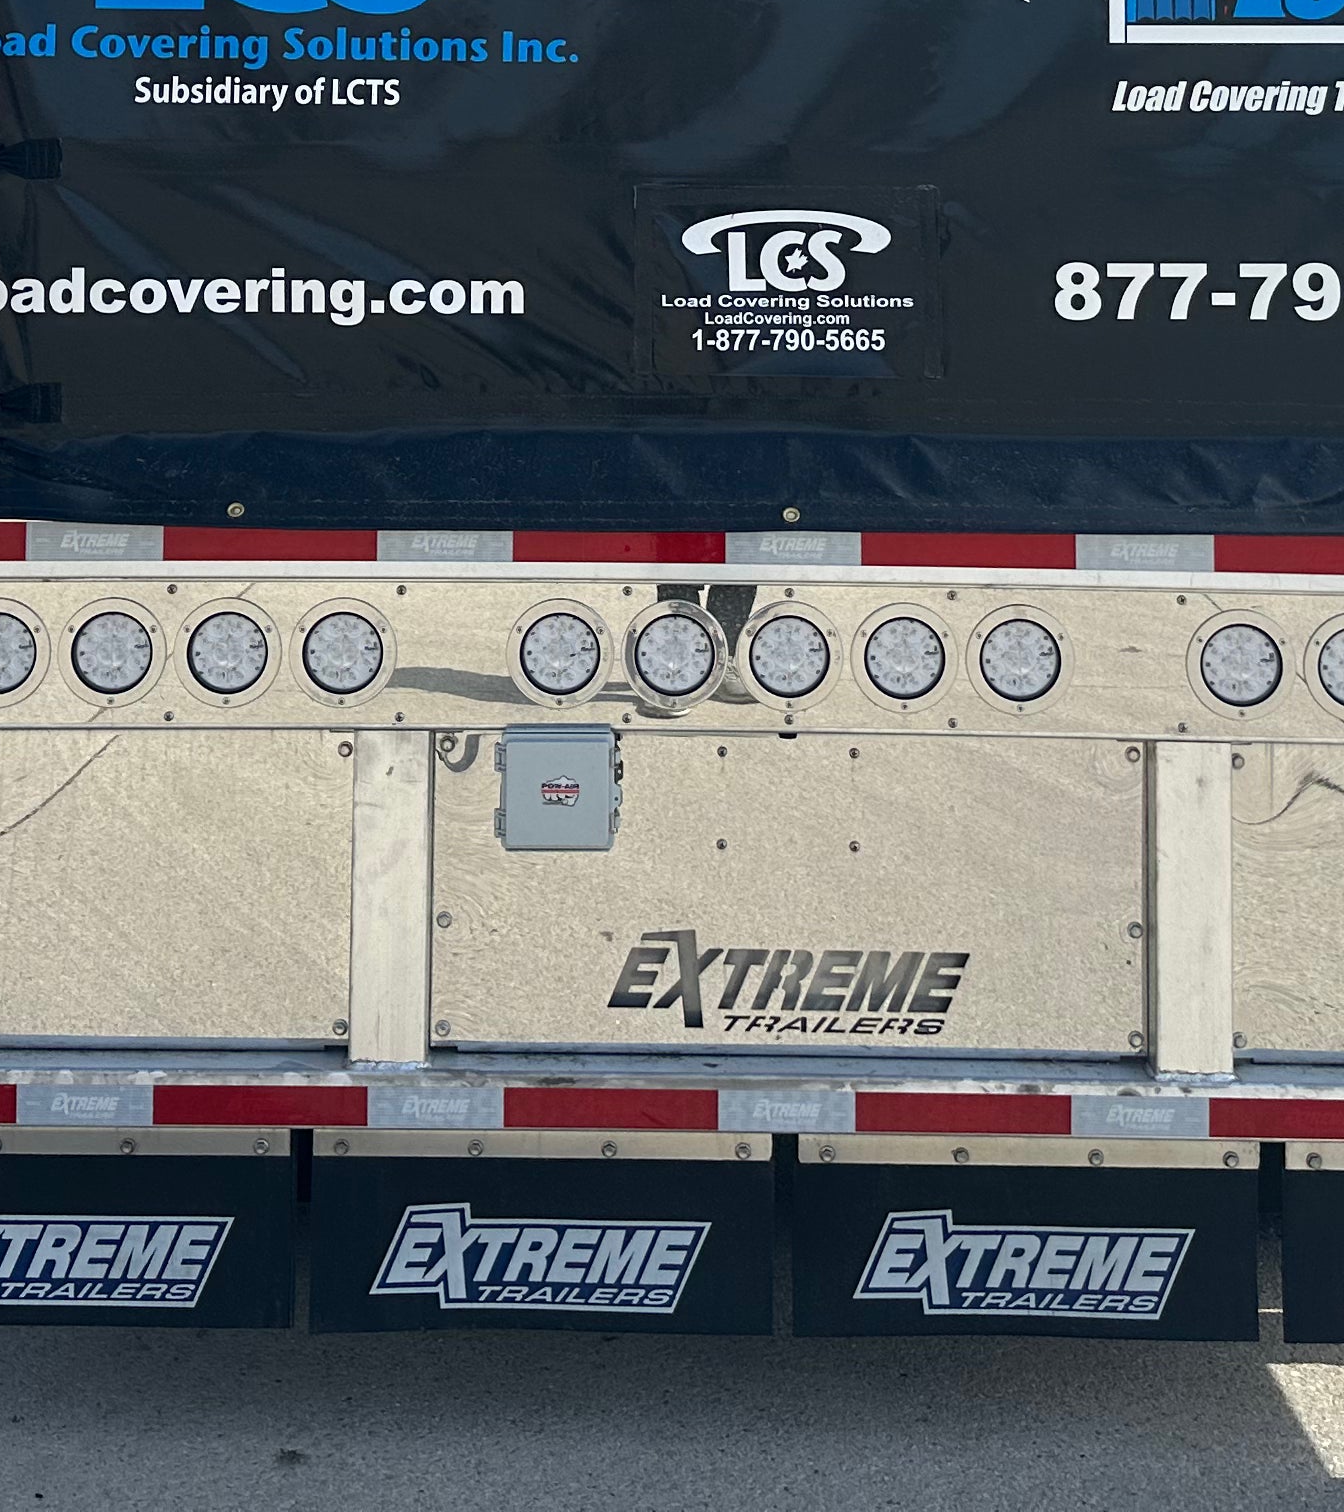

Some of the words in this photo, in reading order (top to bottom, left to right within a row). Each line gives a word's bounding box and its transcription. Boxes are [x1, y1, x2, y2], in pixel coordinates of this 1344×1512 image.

[71, 25, 268, 69] Covering
[283, 27, 487, 62] Solutions
[501, 30, 579, 62] Inc.
[134, 77, 288, 112] Subsidiary
[294, 77, 325, 105] of
[331, 78, 400, 105] LCTS
[1112, 80, 1183, 112] Load
[1190, 81, 1327, 116] Covering
[727, 230, 846, 292] LCS
[661, 294, 711, 308] Load
[718, 294, 810, 311] Covering
[816, 294, 914, 308] Solutions
[704, 312, 850, 327] LoadCovering.com
[691, 329, 886, 352] 1-877-790-5665
[60, 529, 130, 552] EXTREME
[411, 531, 480, 552] EXTREME
[759, 534, 827, 555] EXTREME
[1110, 539, 1179, 561] EXTREME
[607, 929, 970, 1028] EXTREME
[723, 1015, 945, 1034] TRAILERS
[51, 1092, 120, 1115] EXTREME
[401, 1095, 470, 1118] EXTREME
[753, 1099, 822, 1121] EXTREME
[1106, 1104, 1175, 1127] EXTREME
[386, 1212, 696, 1298] EXTREME
[869, 1218, 1179, 1305] EXTREME
[1, 1282, 196, 1300] TRAILERS
[479, 1287, 674, 1305] TRAILERS
[961, 1292, 1159, 1311] TRAILERS
